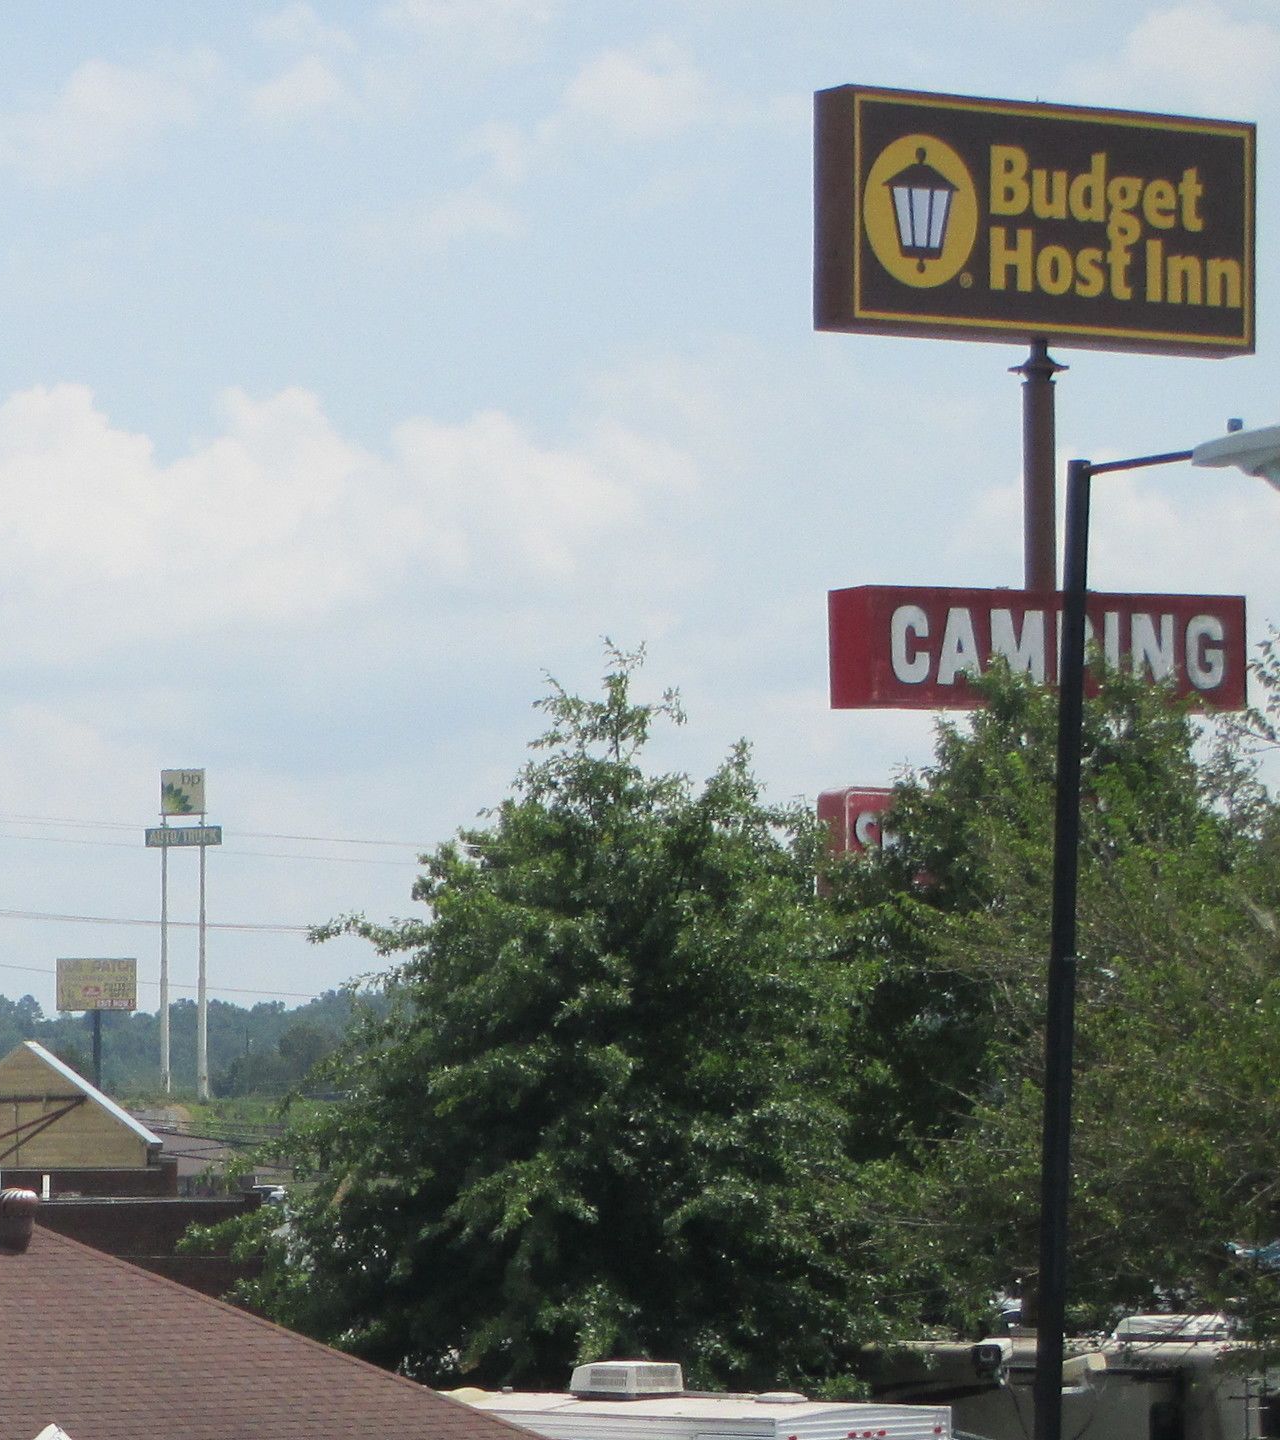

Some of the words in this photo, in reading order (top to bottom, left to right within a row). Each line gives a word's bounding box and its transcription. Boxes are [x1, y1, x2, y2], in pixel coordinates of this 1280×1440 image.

[990, 144, 1205, 246] Budget
[990, 226, 1132, 301] Host
[1146, 239, 1241, 308] Inn
[181, 772, 201, 785] bp
